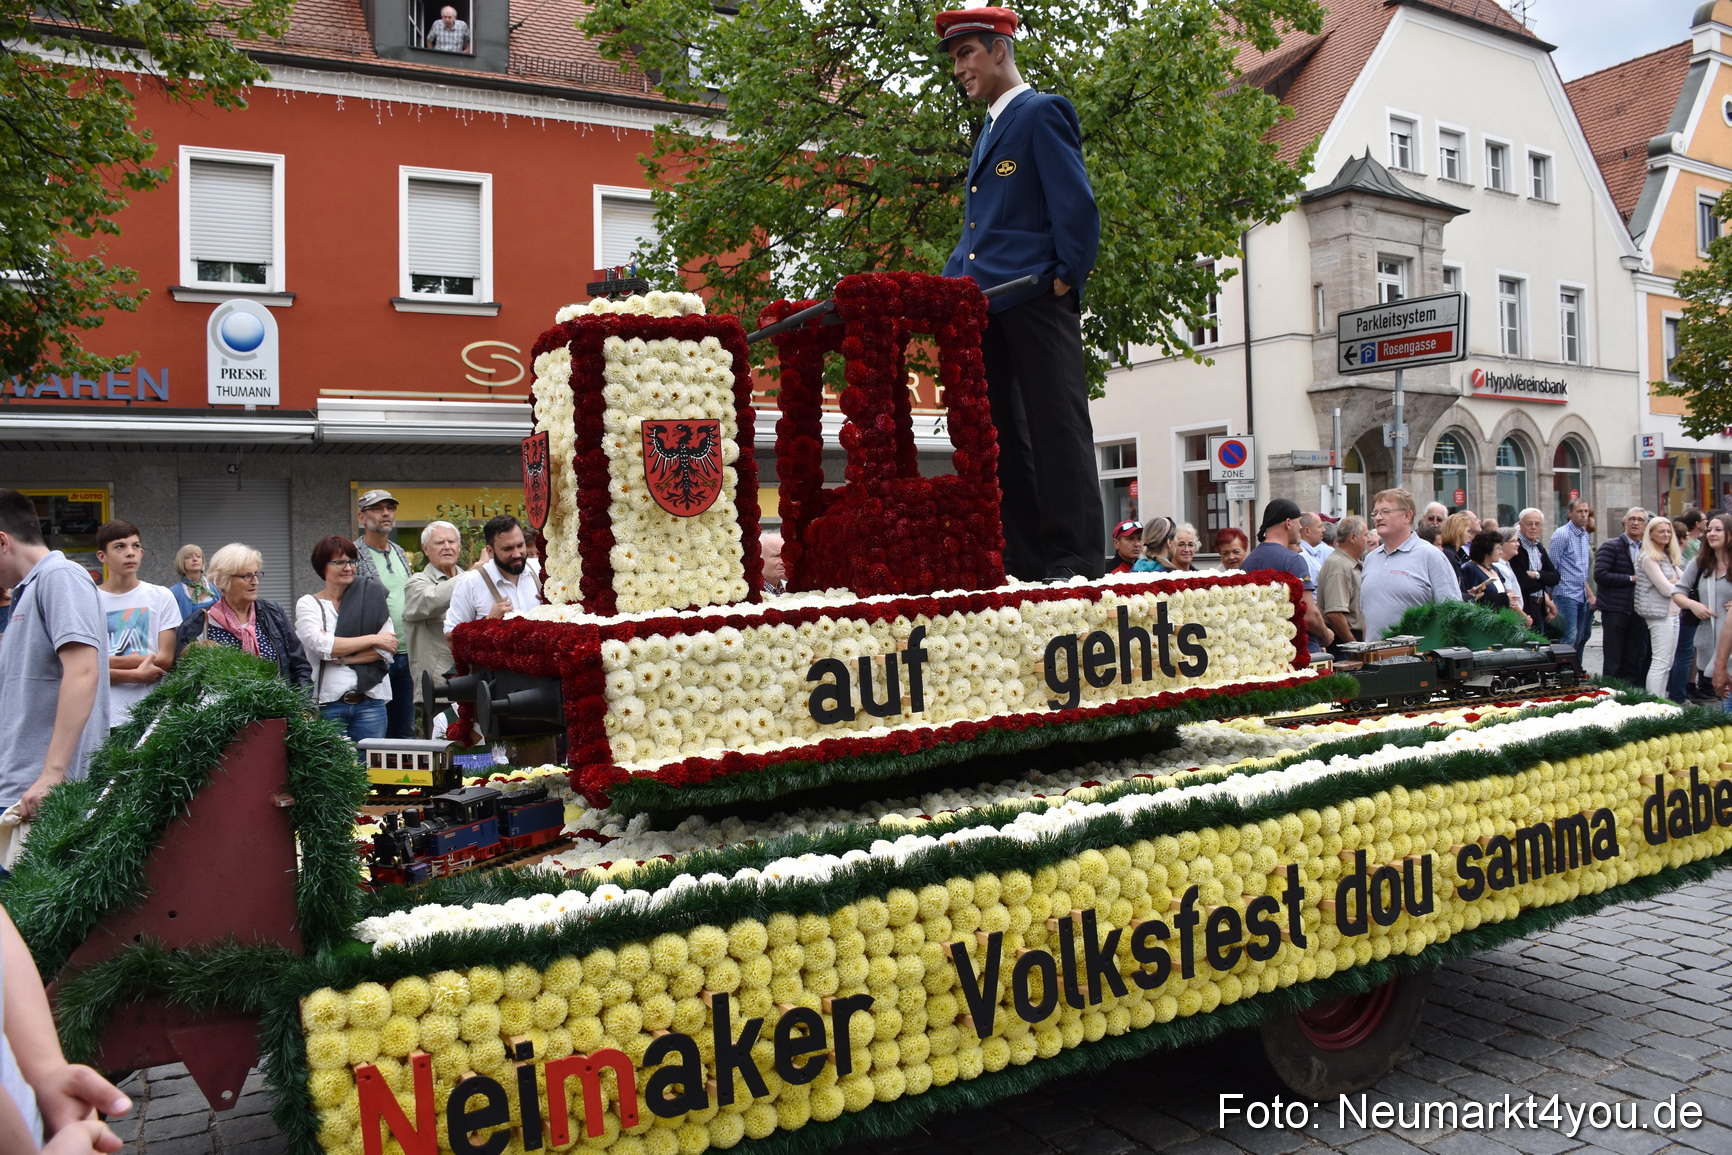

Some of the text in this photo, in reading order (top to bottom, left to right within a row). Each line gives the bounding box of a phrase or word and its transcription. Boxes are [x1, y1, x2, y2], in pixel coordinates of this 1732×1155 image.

[1357, 309, 1436, 333] Parkleitsystem
[1383, 339, 1436, 356] Rosengasse
[221, 368, 267, 380] PRESSE
[1486, 371, 1568, 394] HypoVereinsbank
[216, 386, 271, 397] THUMANN
[1222, 470, 1245, 478] ZONE
[806, 602, 1208, 725] auf gehts
[358, 766, 1732, 1155] Neimaker Volksfest dou samma dabe
